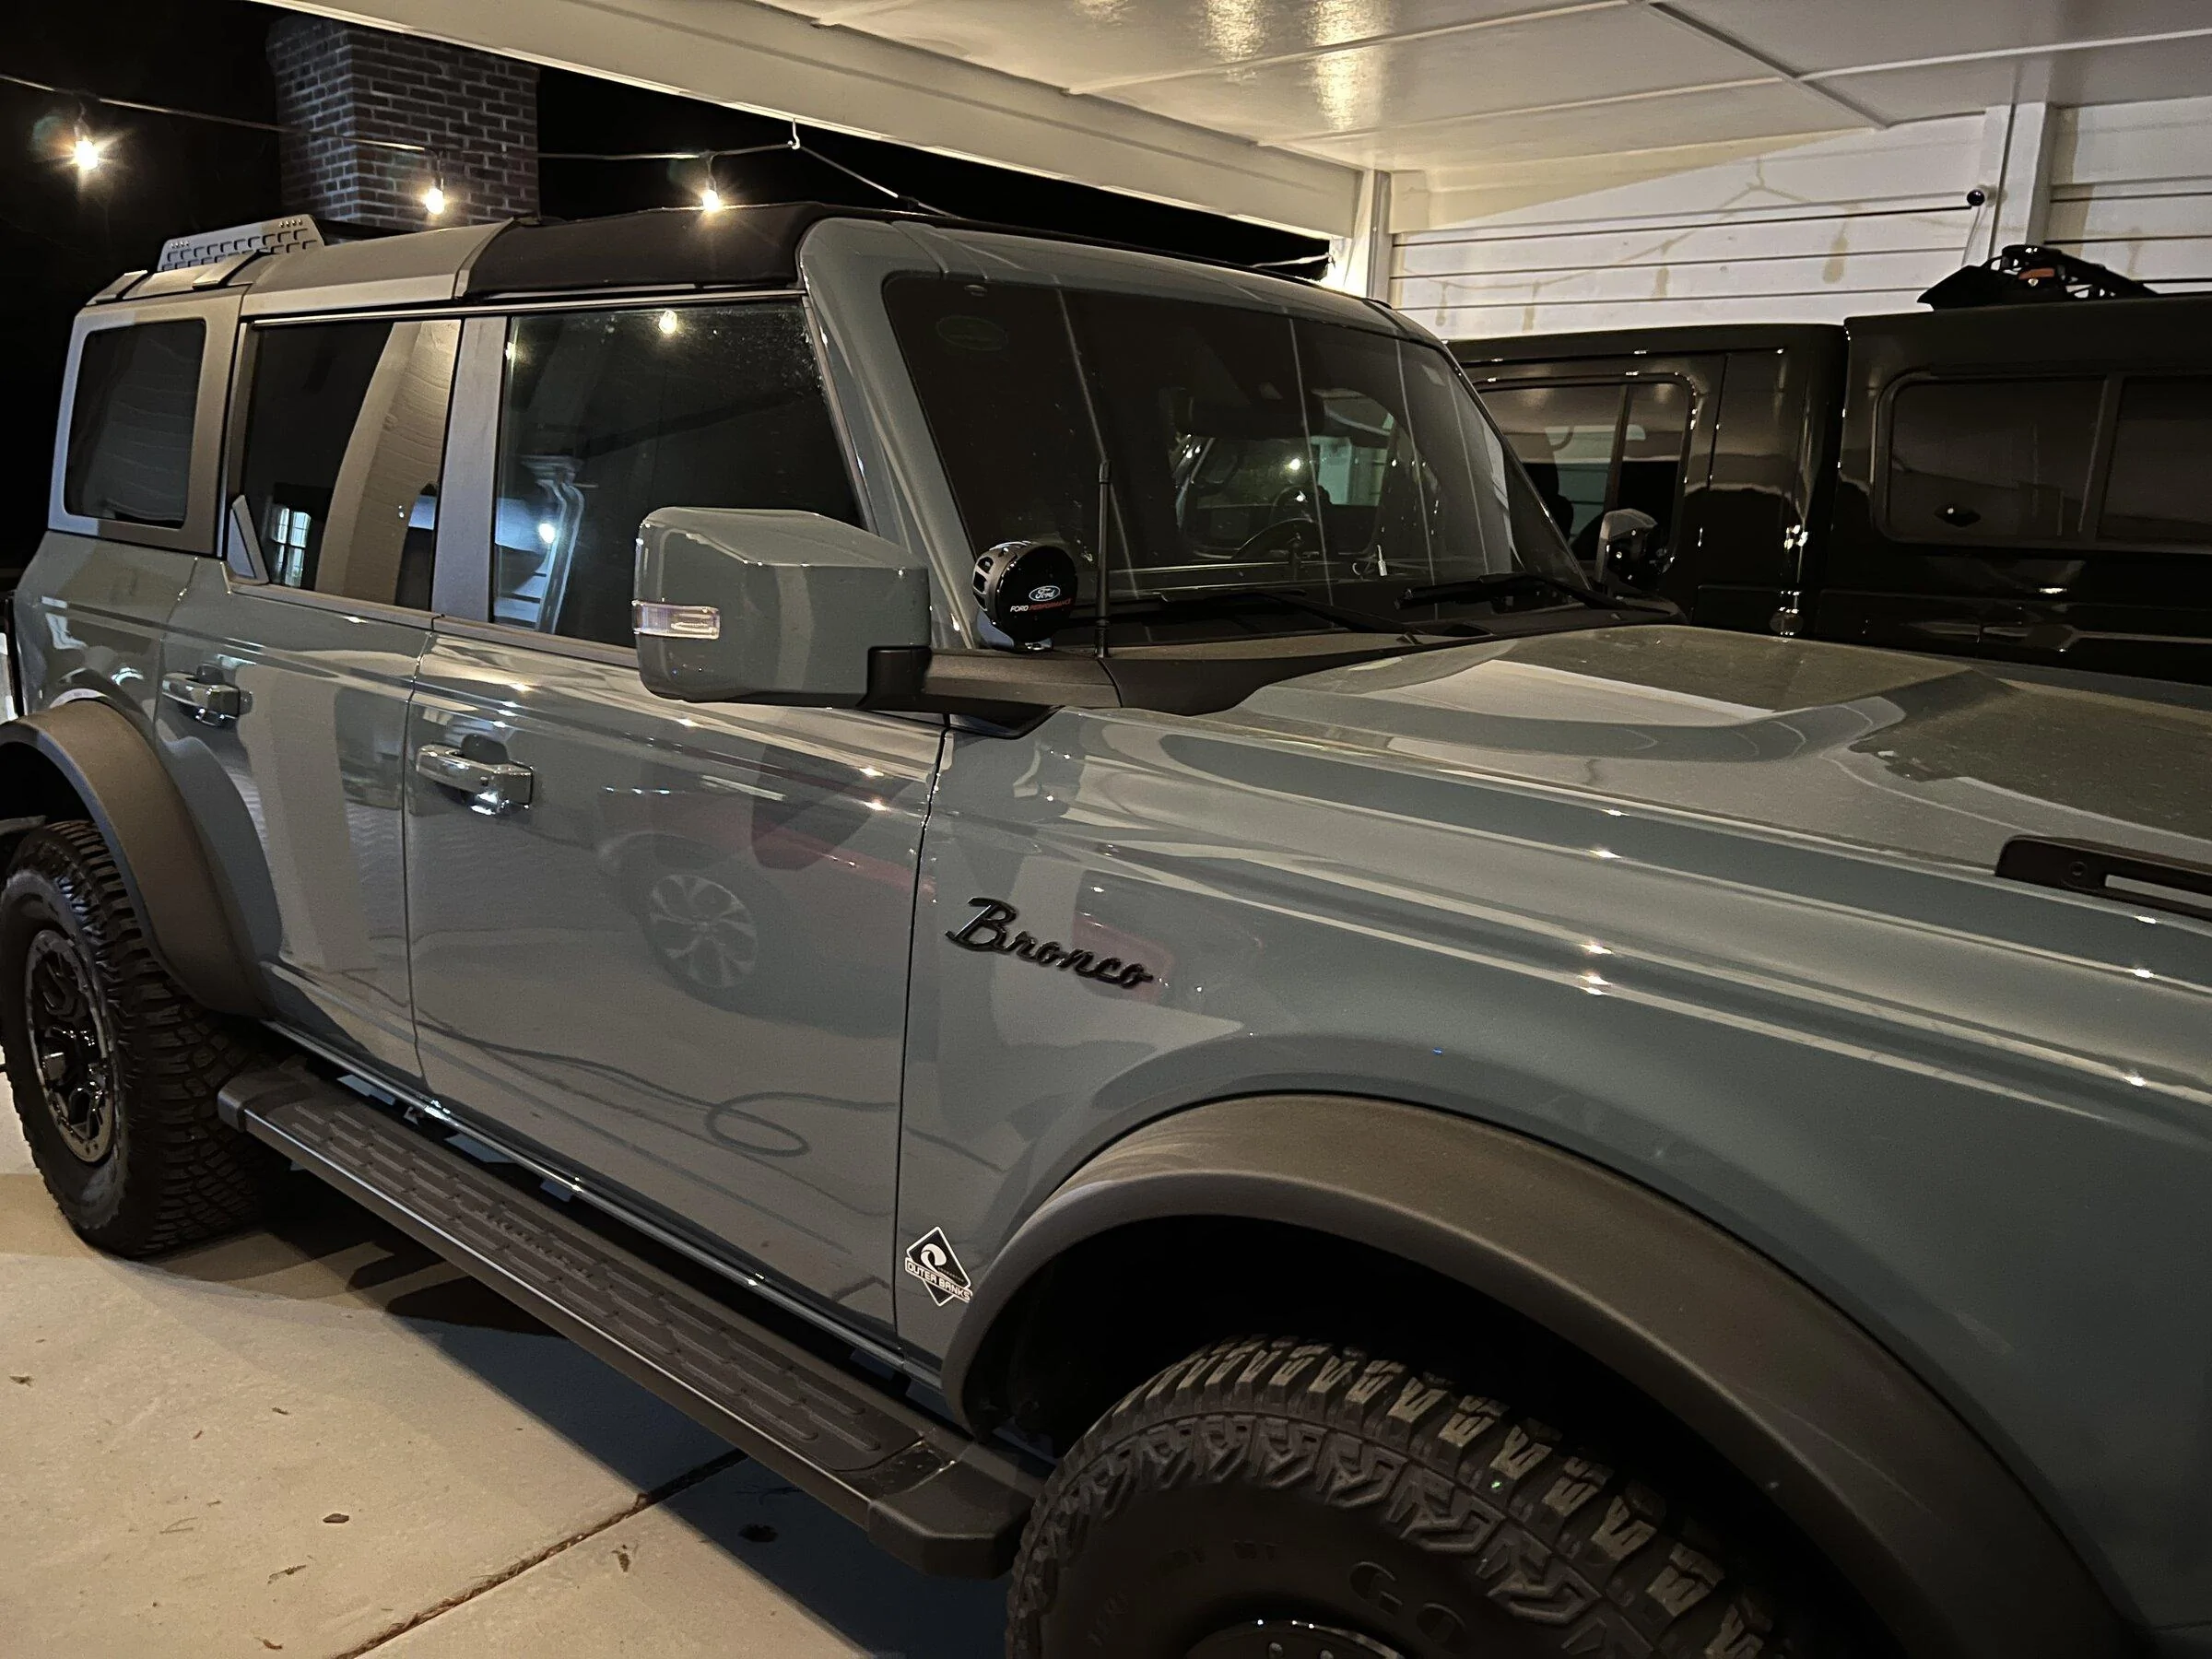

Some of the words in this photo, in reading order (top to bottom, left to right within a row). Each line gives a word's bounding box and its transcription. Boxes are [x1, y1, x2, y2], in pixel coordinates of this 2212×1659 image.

[1009, 605, 1030, 613] FORD
[1029, 597, 1073, 611] PERFORMANCE
[1034, 586, 1055, 600] Ford
[945, 896, 1154, 990] Bronco
[907, 1263, 937, 1284] OUTER
[938, 1275, 971, 1300] BANKS
